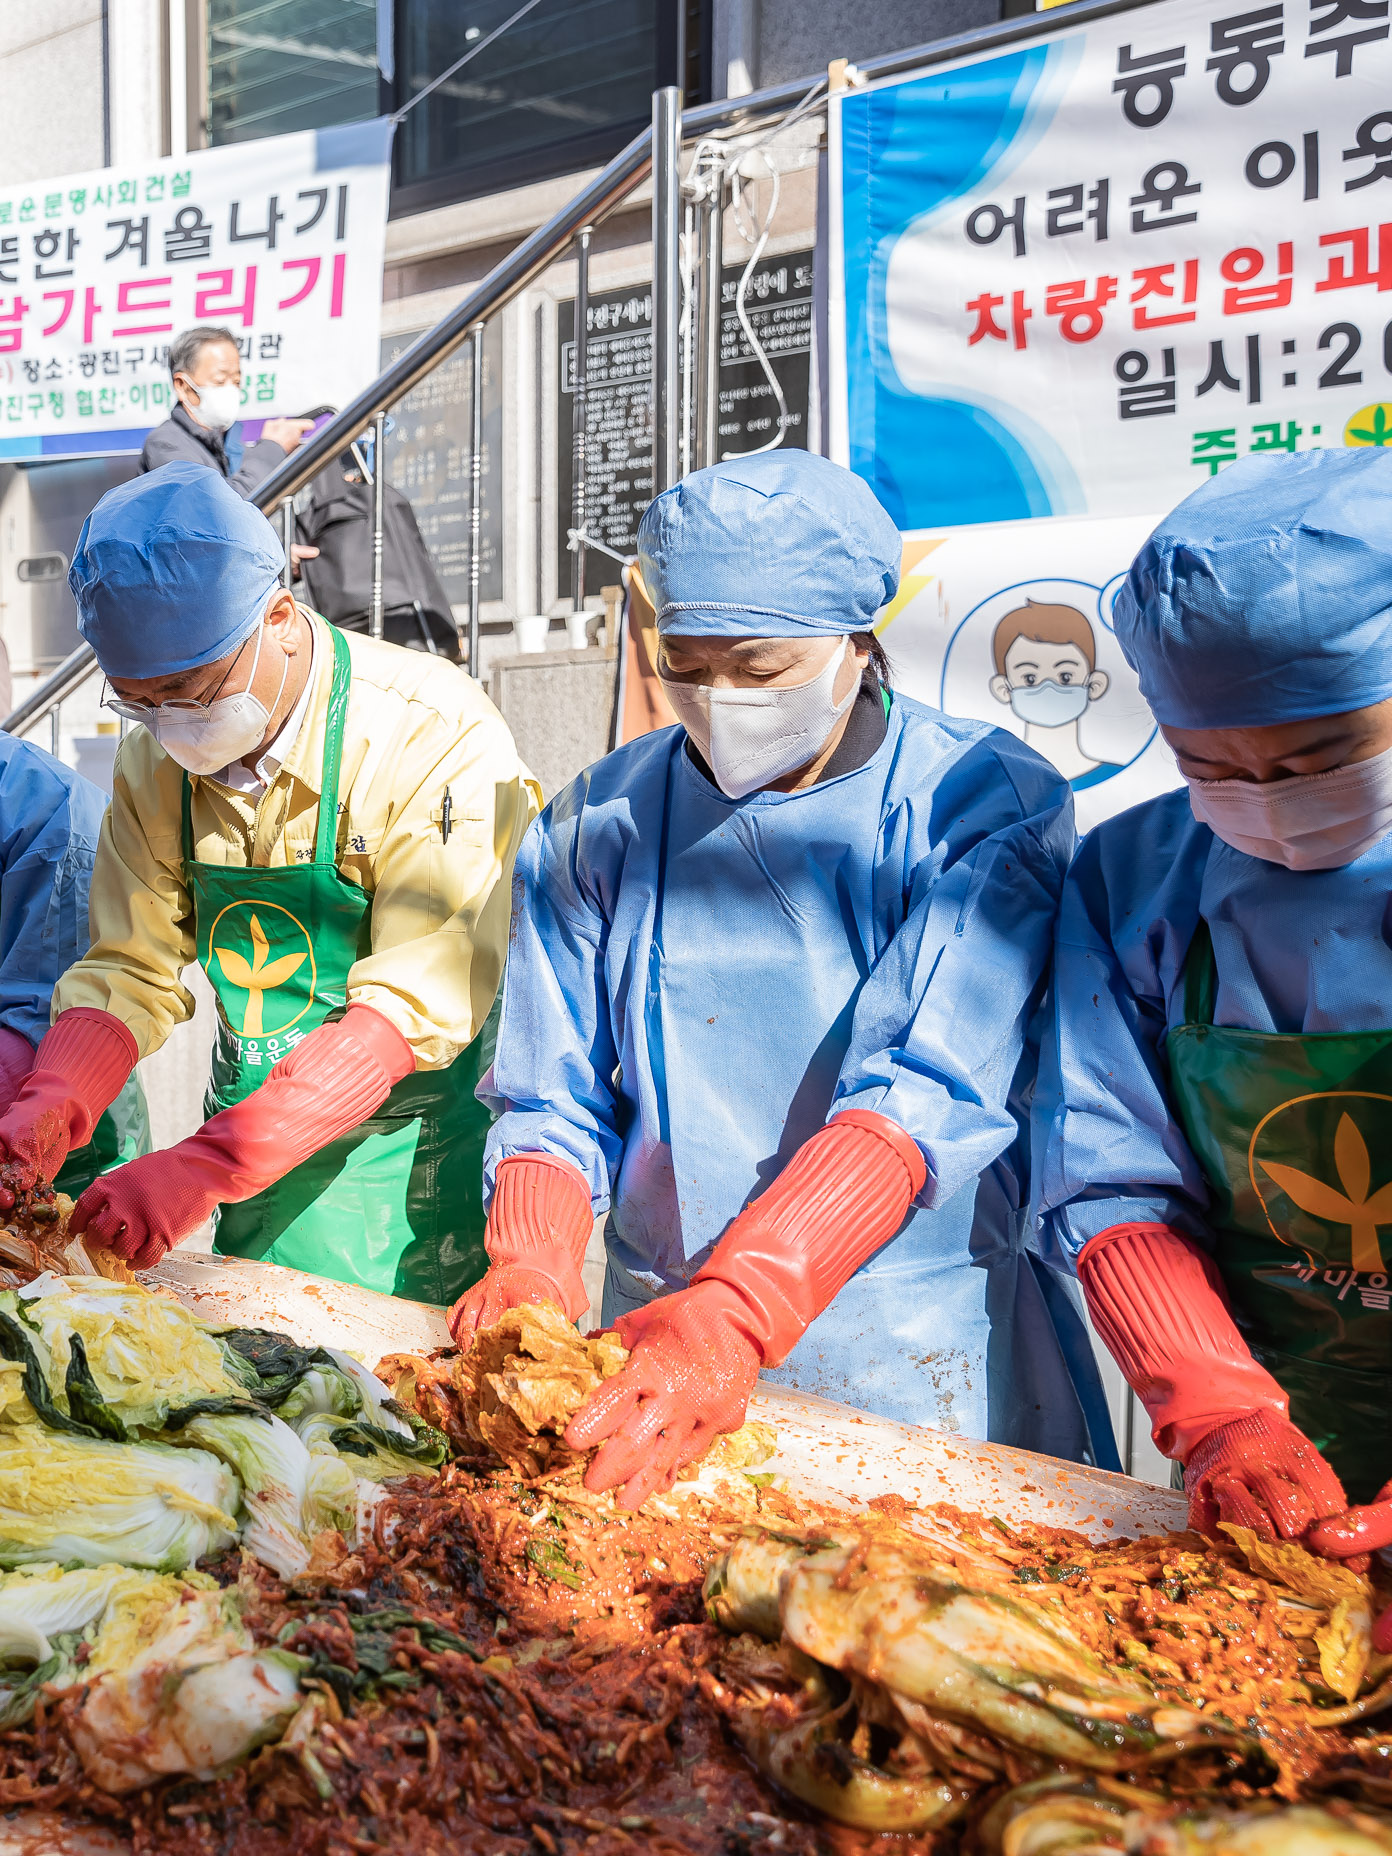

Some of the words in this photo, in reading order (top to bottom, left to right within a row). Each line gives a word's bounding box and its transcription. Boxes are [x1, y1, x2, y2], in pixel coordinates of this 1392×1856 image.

[104, 183, 350, 268] 겨울나기
[965, 160, 1203, 258] 어려운
[1114, 321, 1392, 421] 일시:2
